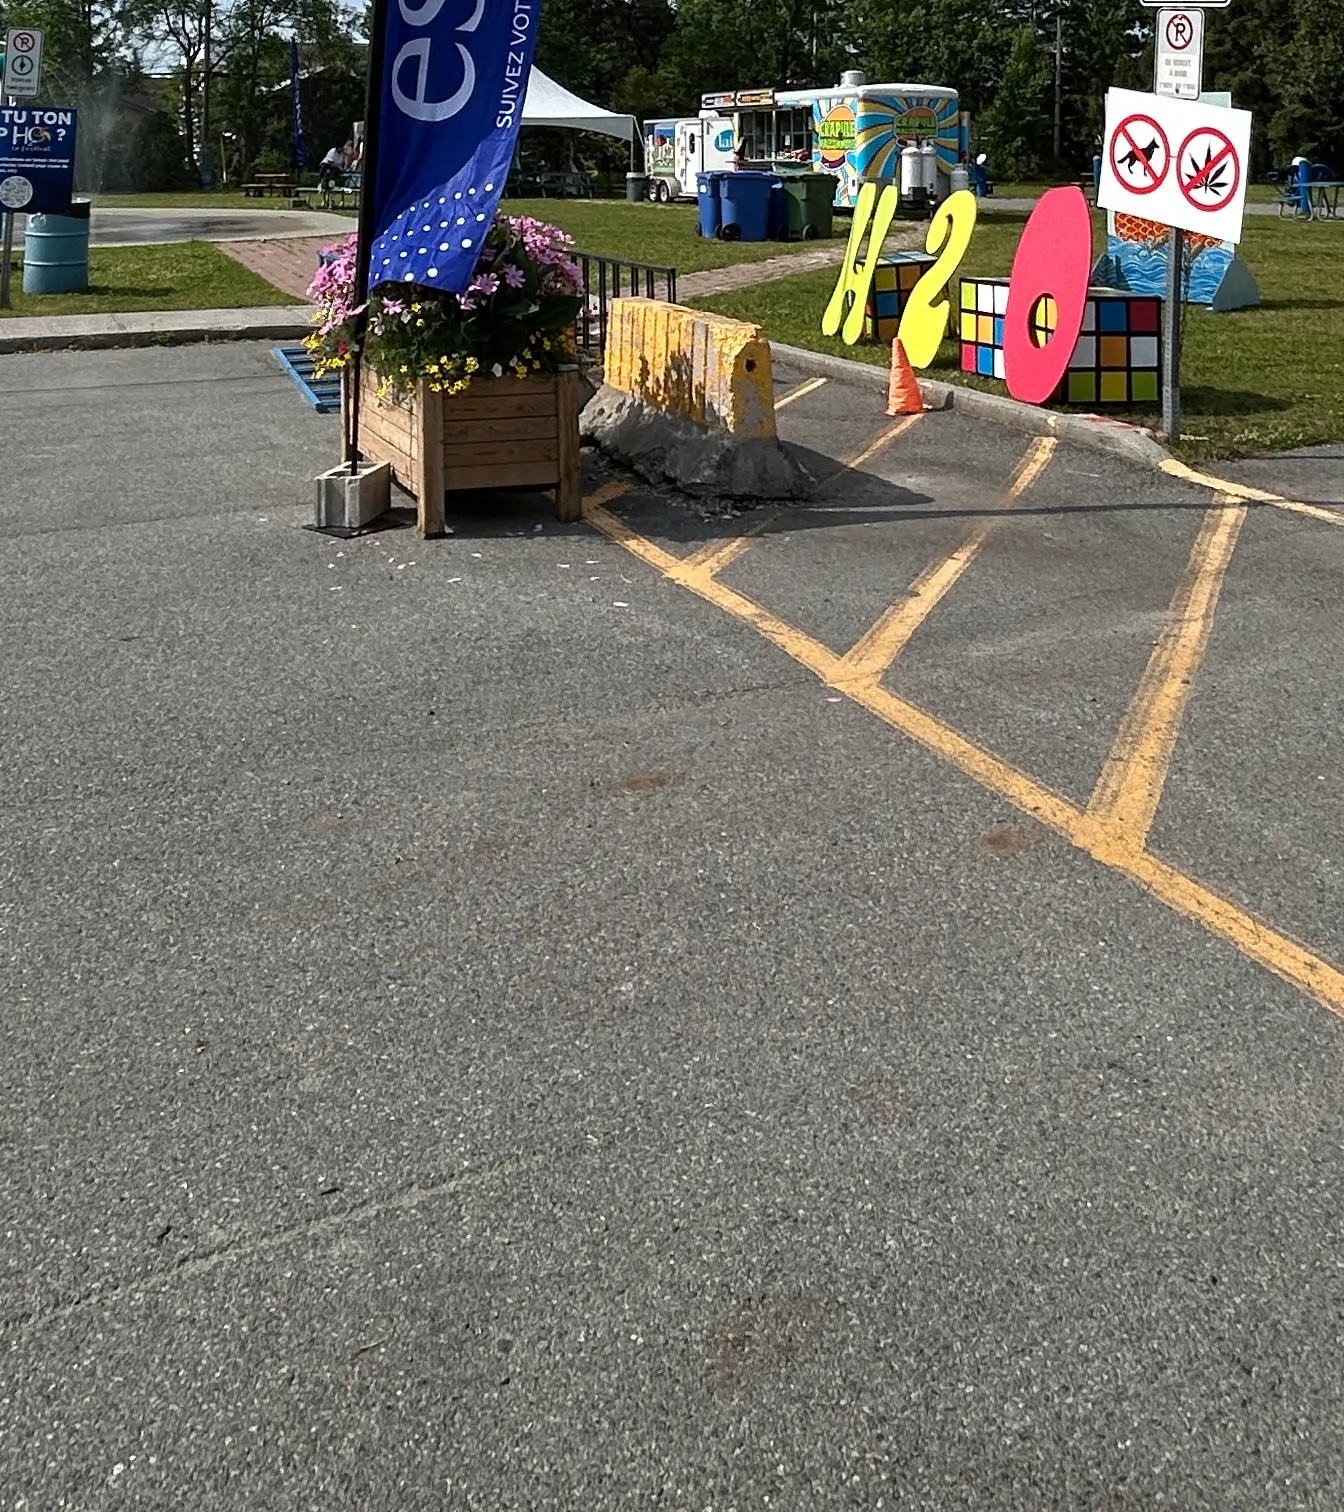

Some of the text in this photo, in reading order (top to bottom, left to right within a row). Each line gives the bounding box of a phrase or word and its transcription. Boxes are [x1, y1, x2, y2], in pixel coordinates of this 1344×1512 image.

[496, 51, 524, 128] SUIVEZ
[1, 109, 27, 124] TU
[32, 111, 72, 126] TON
[56, 128, 67, 141] ?
[820, 119, 856, 138] CRAPULE
